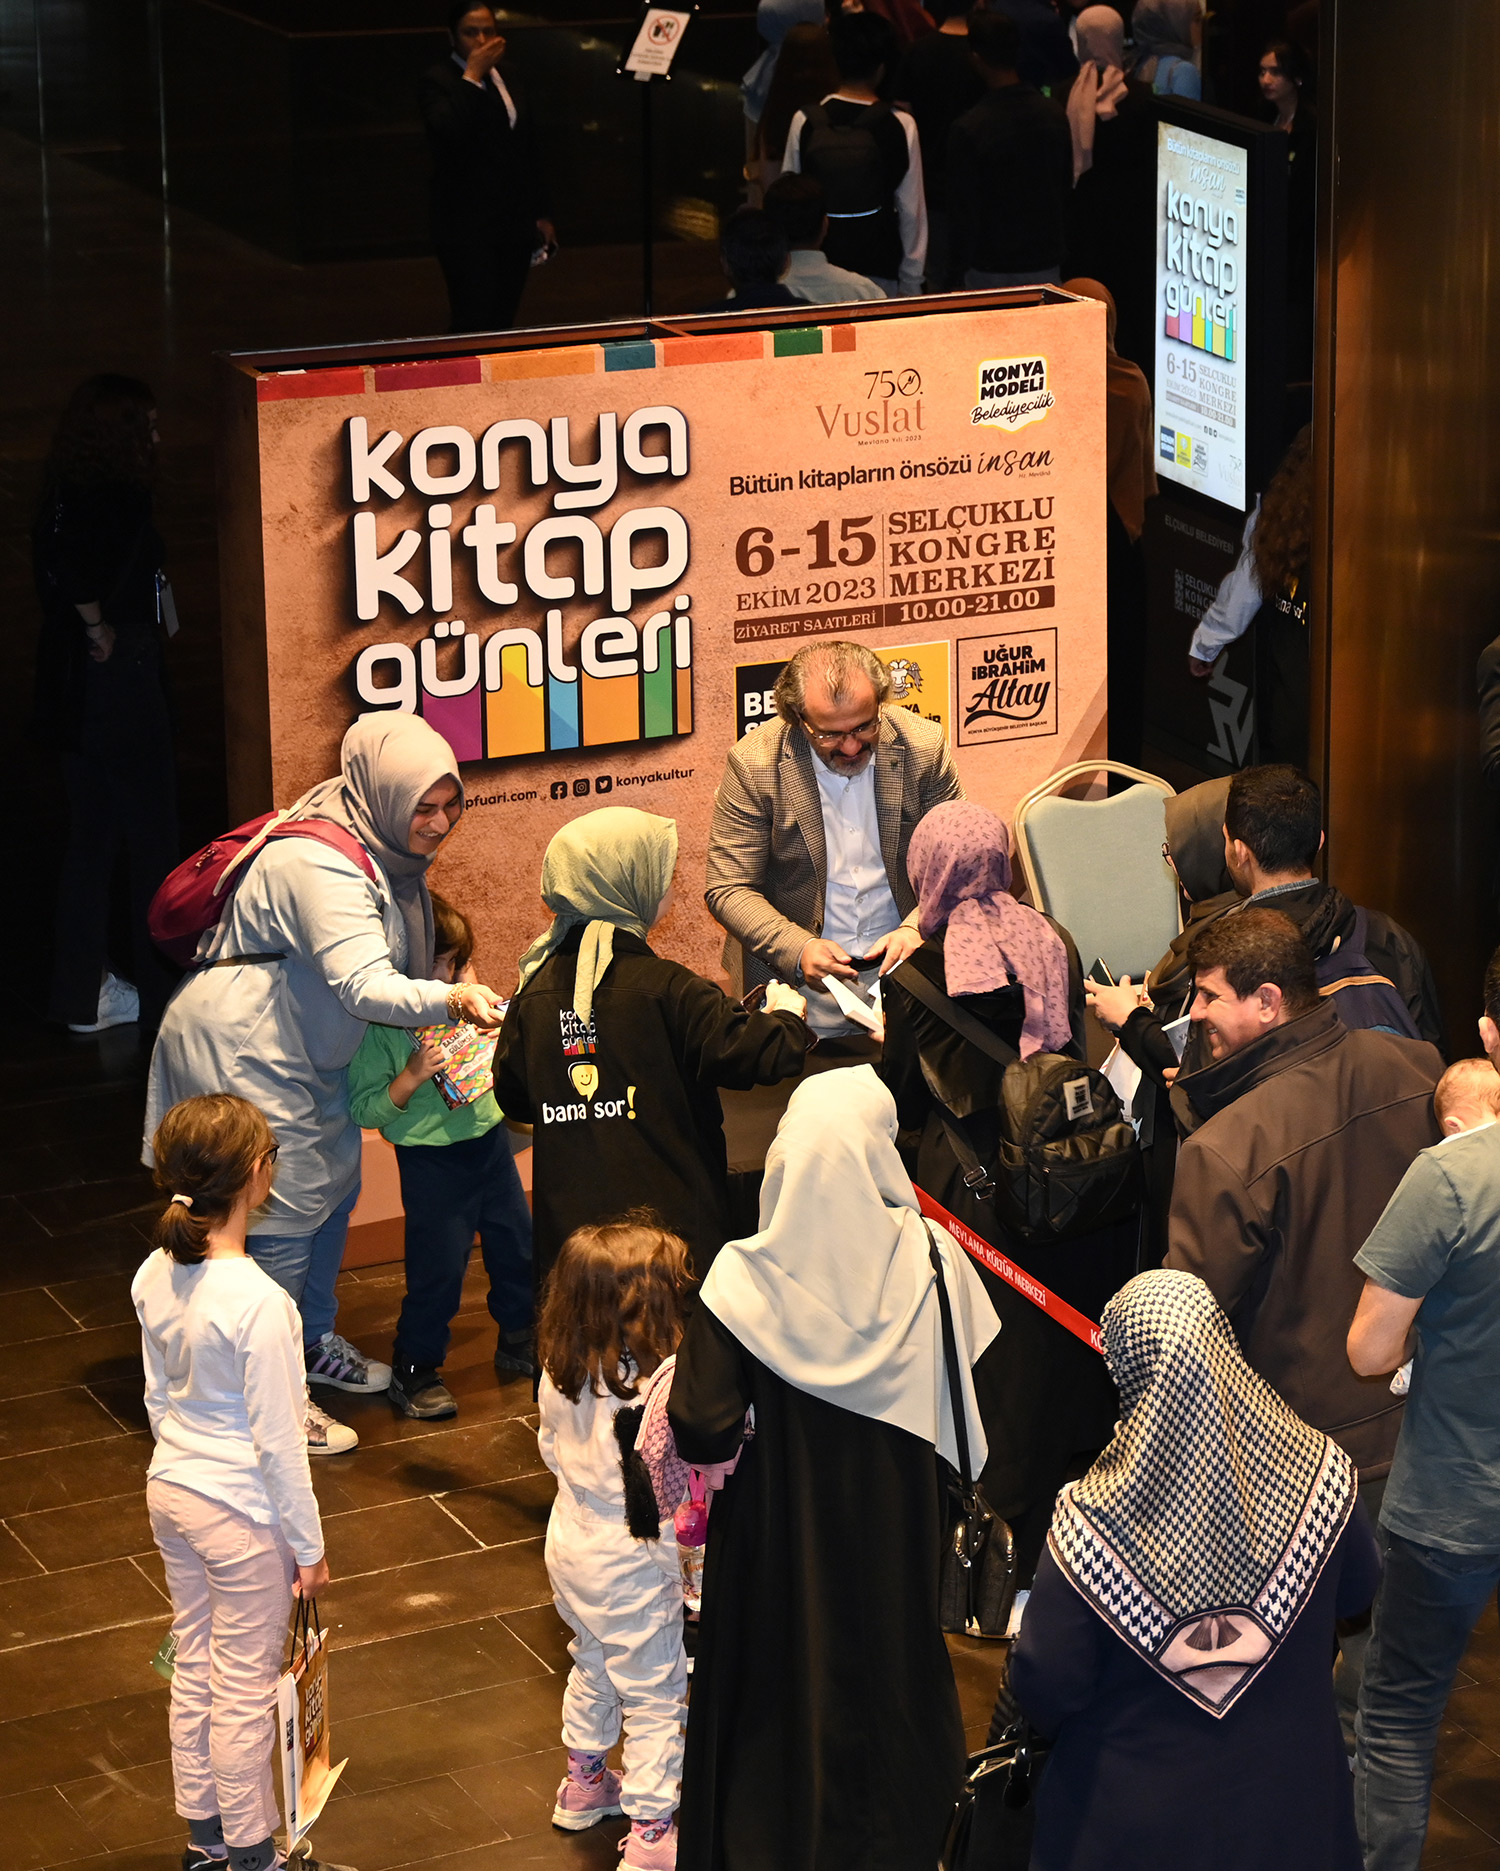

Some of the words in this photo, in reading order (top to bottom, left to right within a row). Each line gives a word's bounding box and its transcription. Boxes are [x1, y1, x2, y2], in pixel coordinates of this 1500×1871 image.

[1167, 180, 1238, 248] konya
[1167, 221, 1238, 299] kitap
[1166, 279, 1237, 331] günleri
[982, 360, 1044, 384] KONYA
[1166, 353, 1197, 383] 6-15
[971, 392, 1054, 424] Belediyecilik
[1199, 377, 1237, 402] KONGRE
[815, 399, 927, 439] Vuslat
[349, 405, 689, 511] konya
[730, 472, 793, 496] Bütün
[798, 465, 895, 491] kitapların
[900, 454, 972, 480] önsözü
[977, 450, 1055, 476] insan
[888, 496, 1055, 536] SELÇUKLU
[353, 503, 690, 621] kitap
[735, 515, 877, 578] 6-15
[889, 526, 1056, 567] KONGRE
[736, 585, 801, 611] EKİM
[805, 577, 876, 605] 2023
[889, 551, 1056, 598] MERKEZİ
[736, 620, 800, 640] ZİYARET
[803, 610, 877, 633] SAATLERİ
[900, 589, 1041, 622] 10.00-21.00
[355, 594, 692, 720] günleri
[984, 644, 1033, 664] UĞUR
[965, 678, 1051, 726] Altay
[616, 768, 695, 788] konyakultur
[465, 789, 537, 810] pfuari.com
[542, 1102, 587, 1124] bana
[594, 1086, 637, 1120] sor!
[948, 1219, 986, 1259] MEVLANA
[986, 1249, 1014, 1281] KÜLTÜR
[1014, 1272, 1047, 1307] MERKEZİ
